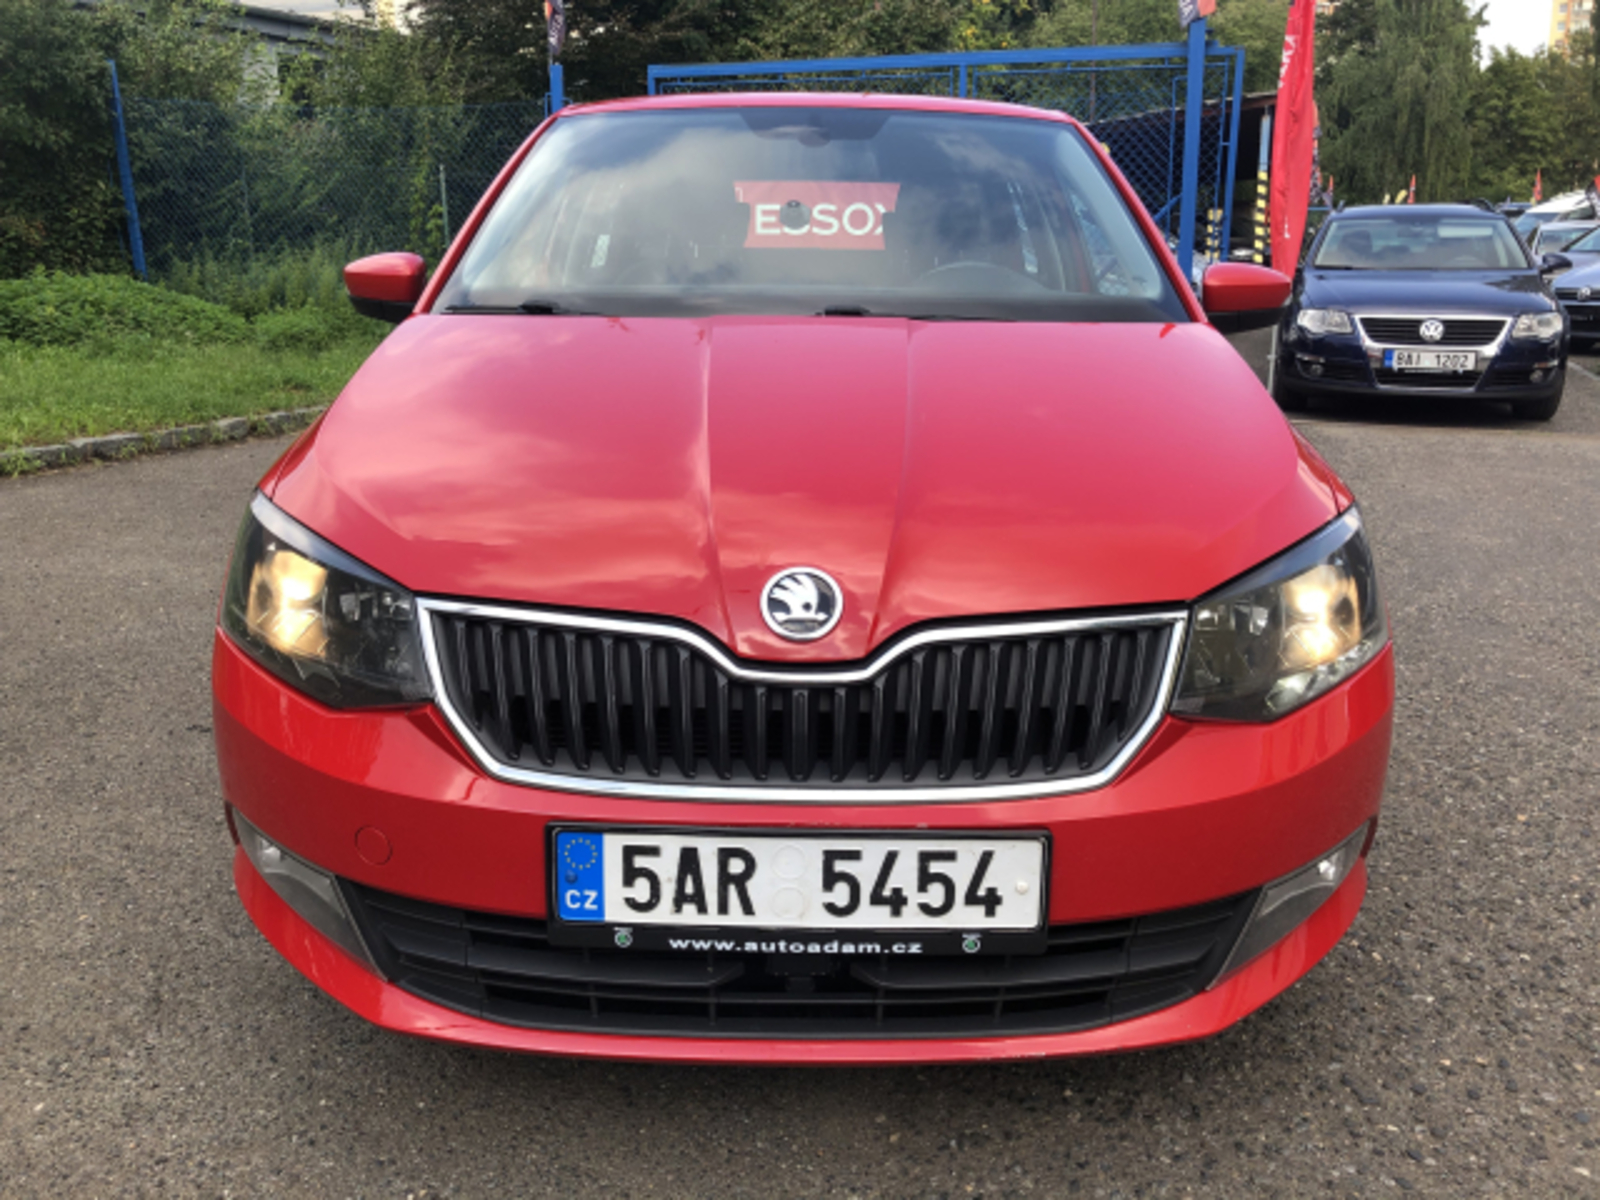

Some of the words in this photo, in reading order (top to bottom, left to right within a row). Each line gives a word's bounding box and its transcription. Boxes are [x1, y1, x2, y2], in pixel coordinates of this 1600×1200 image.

[622, 844, 757, 916] 5AR
[821, 848, 1003, 918] 5454
[565, 890, 598, 910] CZ
[668, 938, 924, 954] www.autoadam.cz
